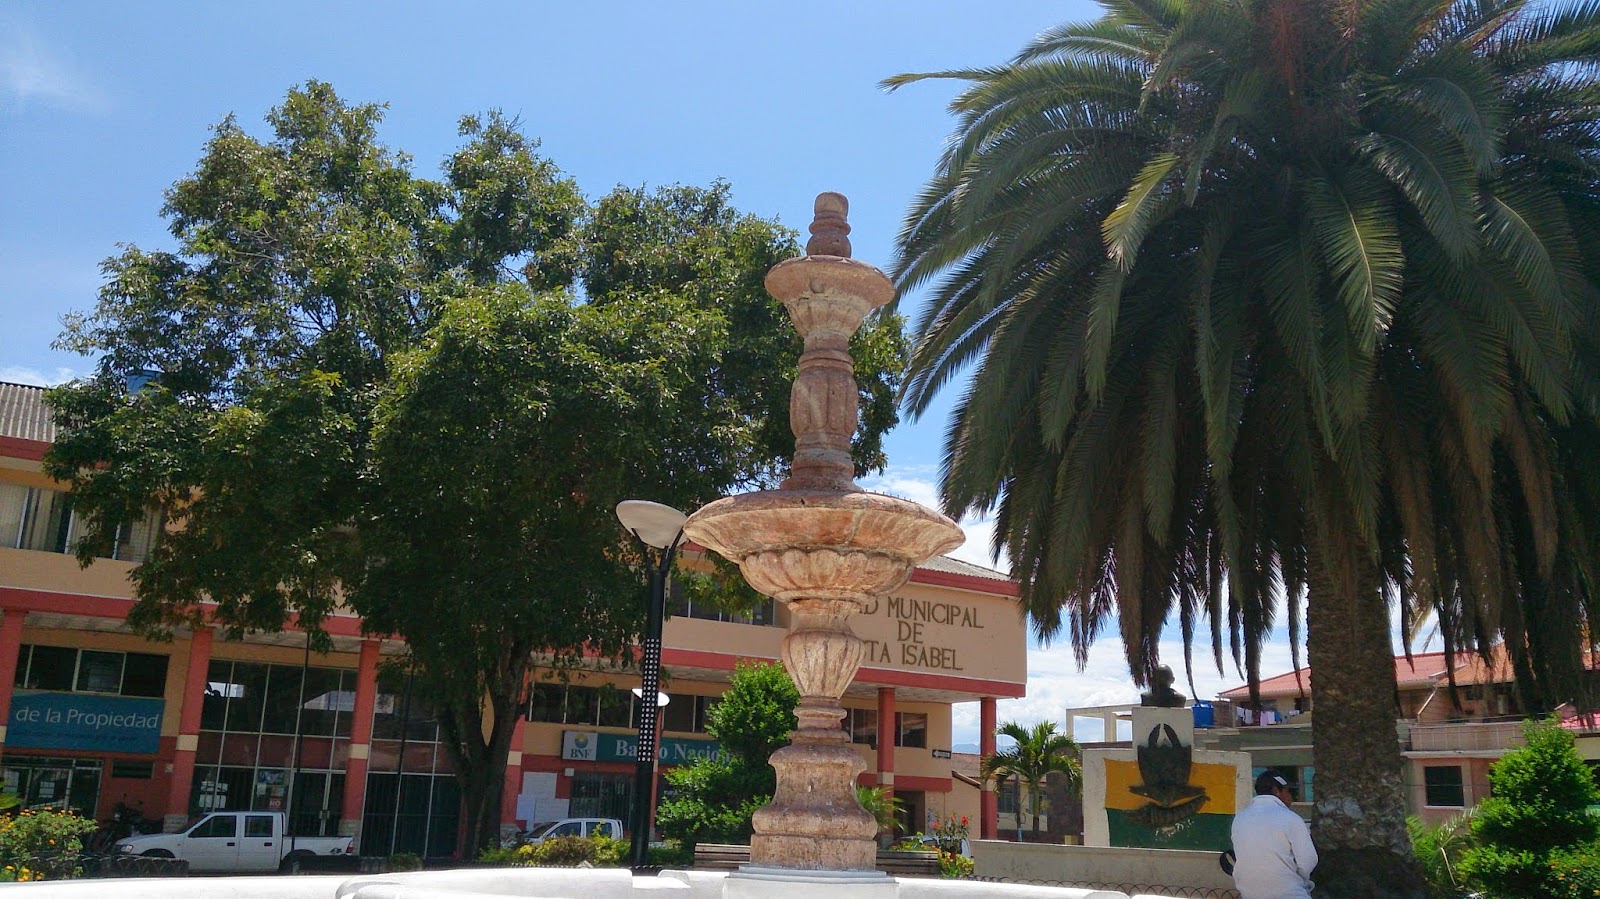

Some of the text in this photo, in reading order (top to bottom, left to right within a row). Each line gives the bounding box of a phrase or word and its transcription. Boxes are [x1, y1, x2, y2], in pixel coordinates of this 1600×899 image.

[887, 596, 984, 629] MUNICIPAL
[897, 620, 925, 644] DE
[901, 643, 964, 671] ISABEL
[15, 706, 160, 730] de la Propiedad
[570, 748, 592, 759] BNF
[615, 738, 668, 759] Bao
